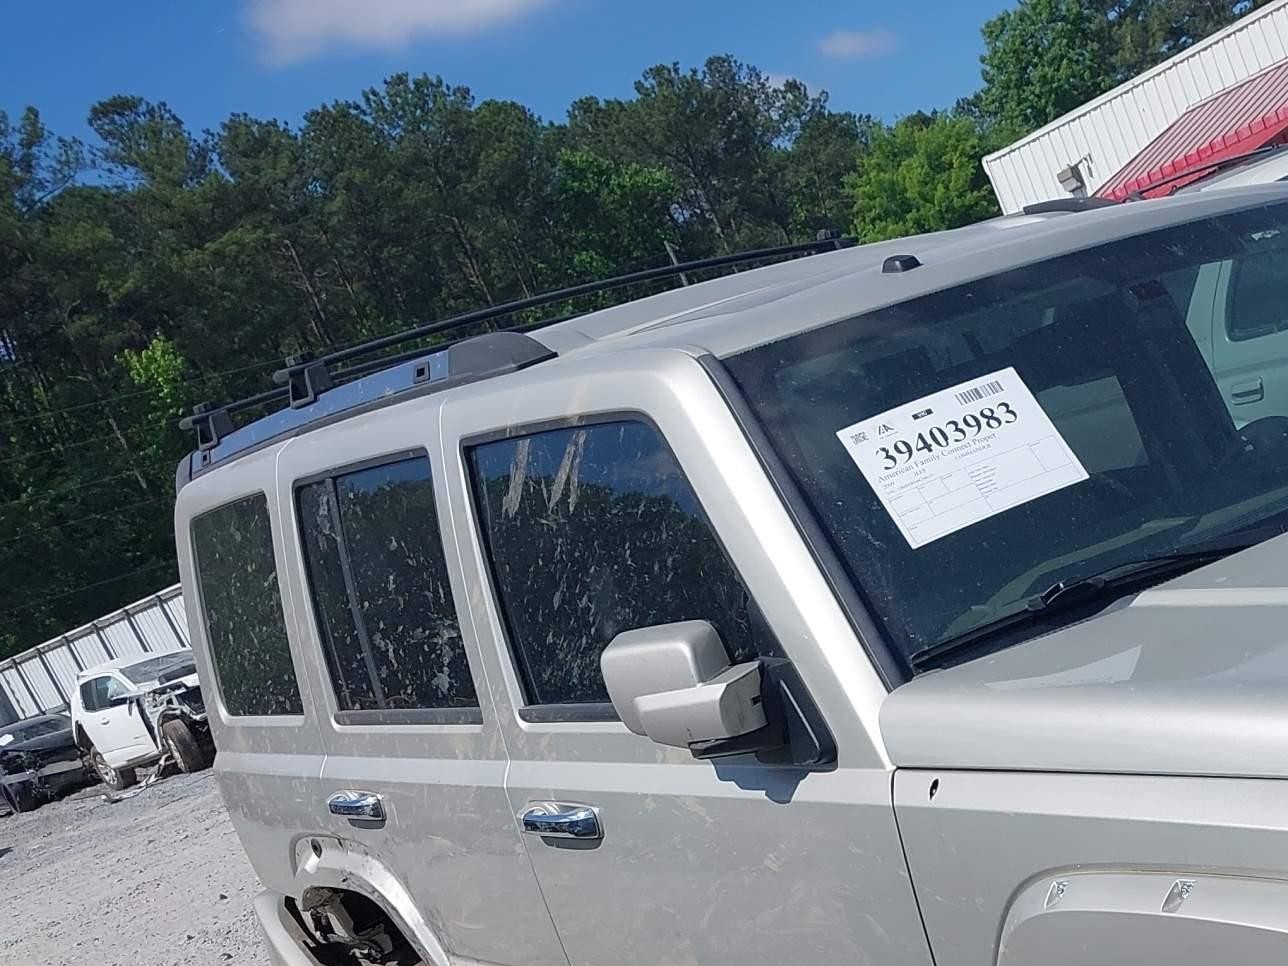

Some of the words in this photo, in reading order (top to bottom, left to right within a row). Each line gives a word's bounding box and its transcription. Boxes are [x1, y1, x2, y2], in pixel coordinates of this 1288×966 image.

[875, 402, 1018, 470] 39403983
[878, 464, 915, 483] American
[913, 453, 941, 469] Family
[941, 441, 973, 458] Connect
[972, 432, 997, 448] Proper
